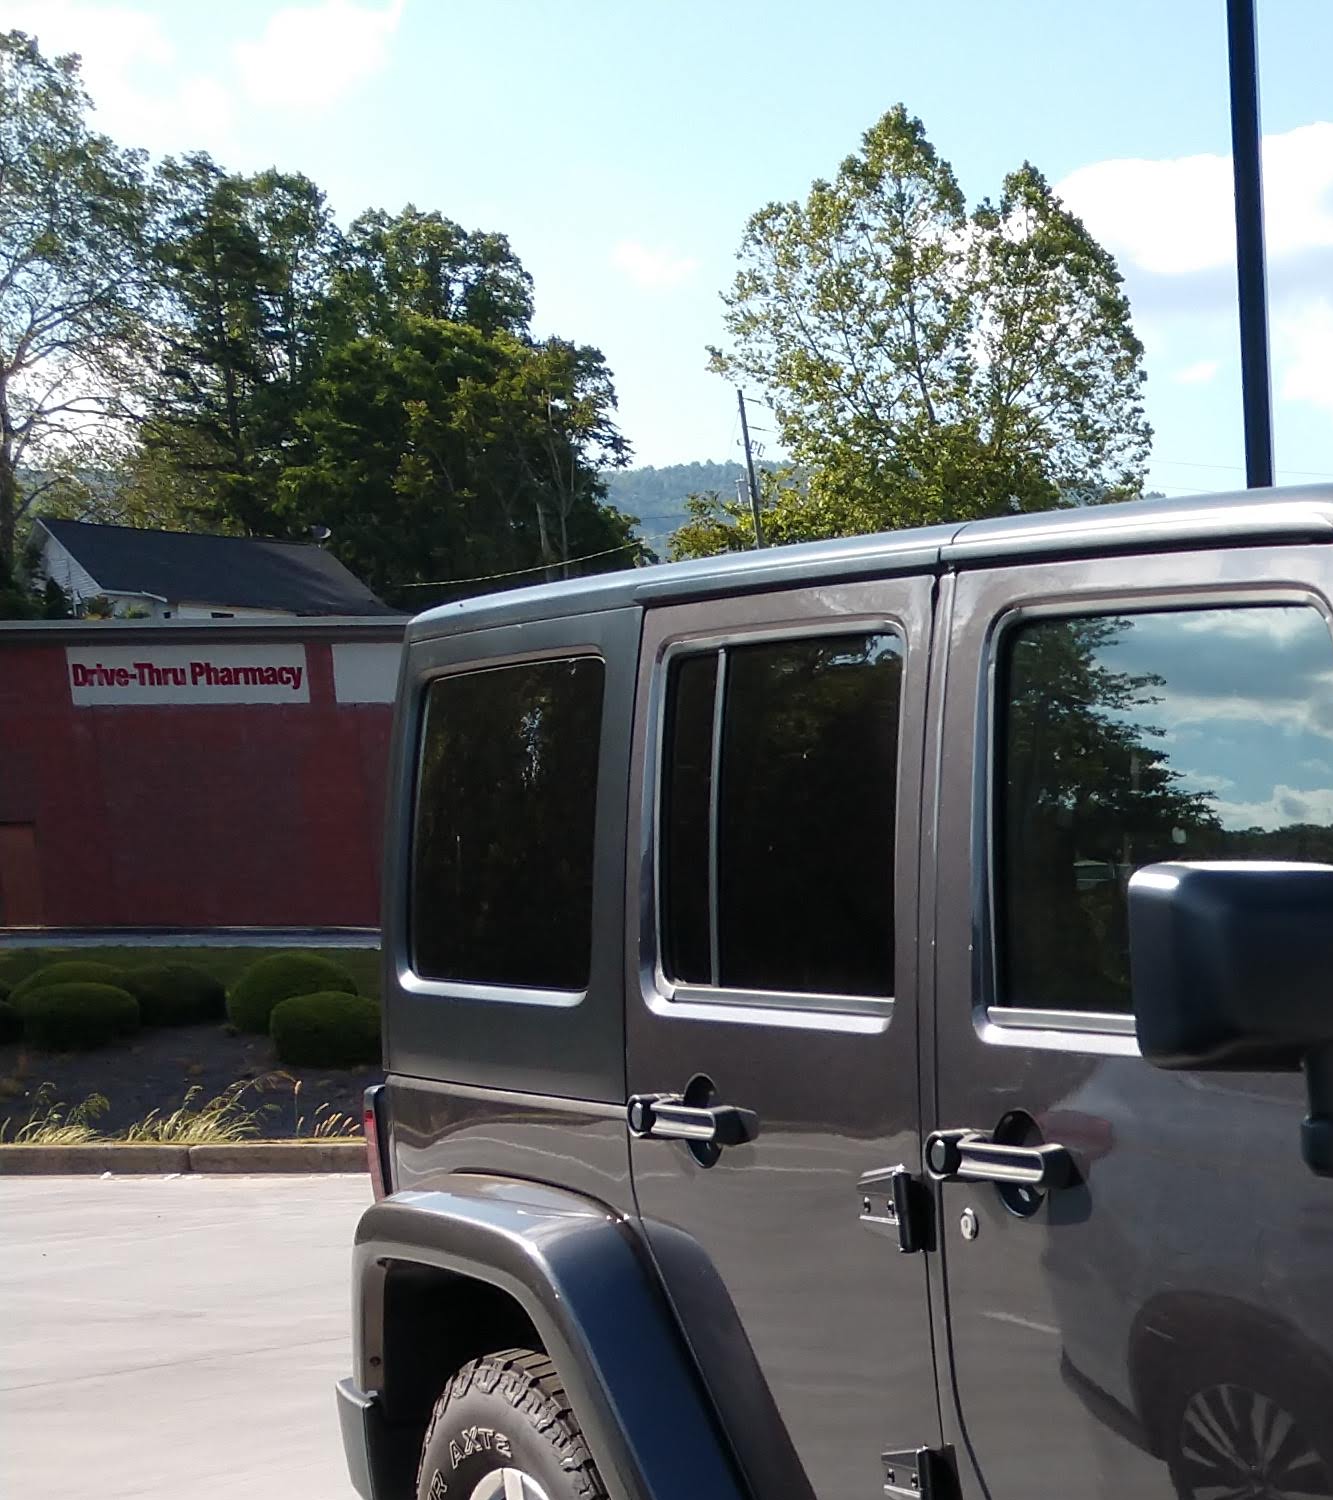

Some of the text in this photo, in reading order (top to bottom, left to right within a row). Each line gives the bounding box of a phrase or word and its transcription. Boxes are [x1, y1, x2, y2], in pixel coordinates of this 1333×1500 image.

[72, 662, 303, 691] Drive-Thru Pharmacy
[450, 1425, 513, 1470] AXT2
